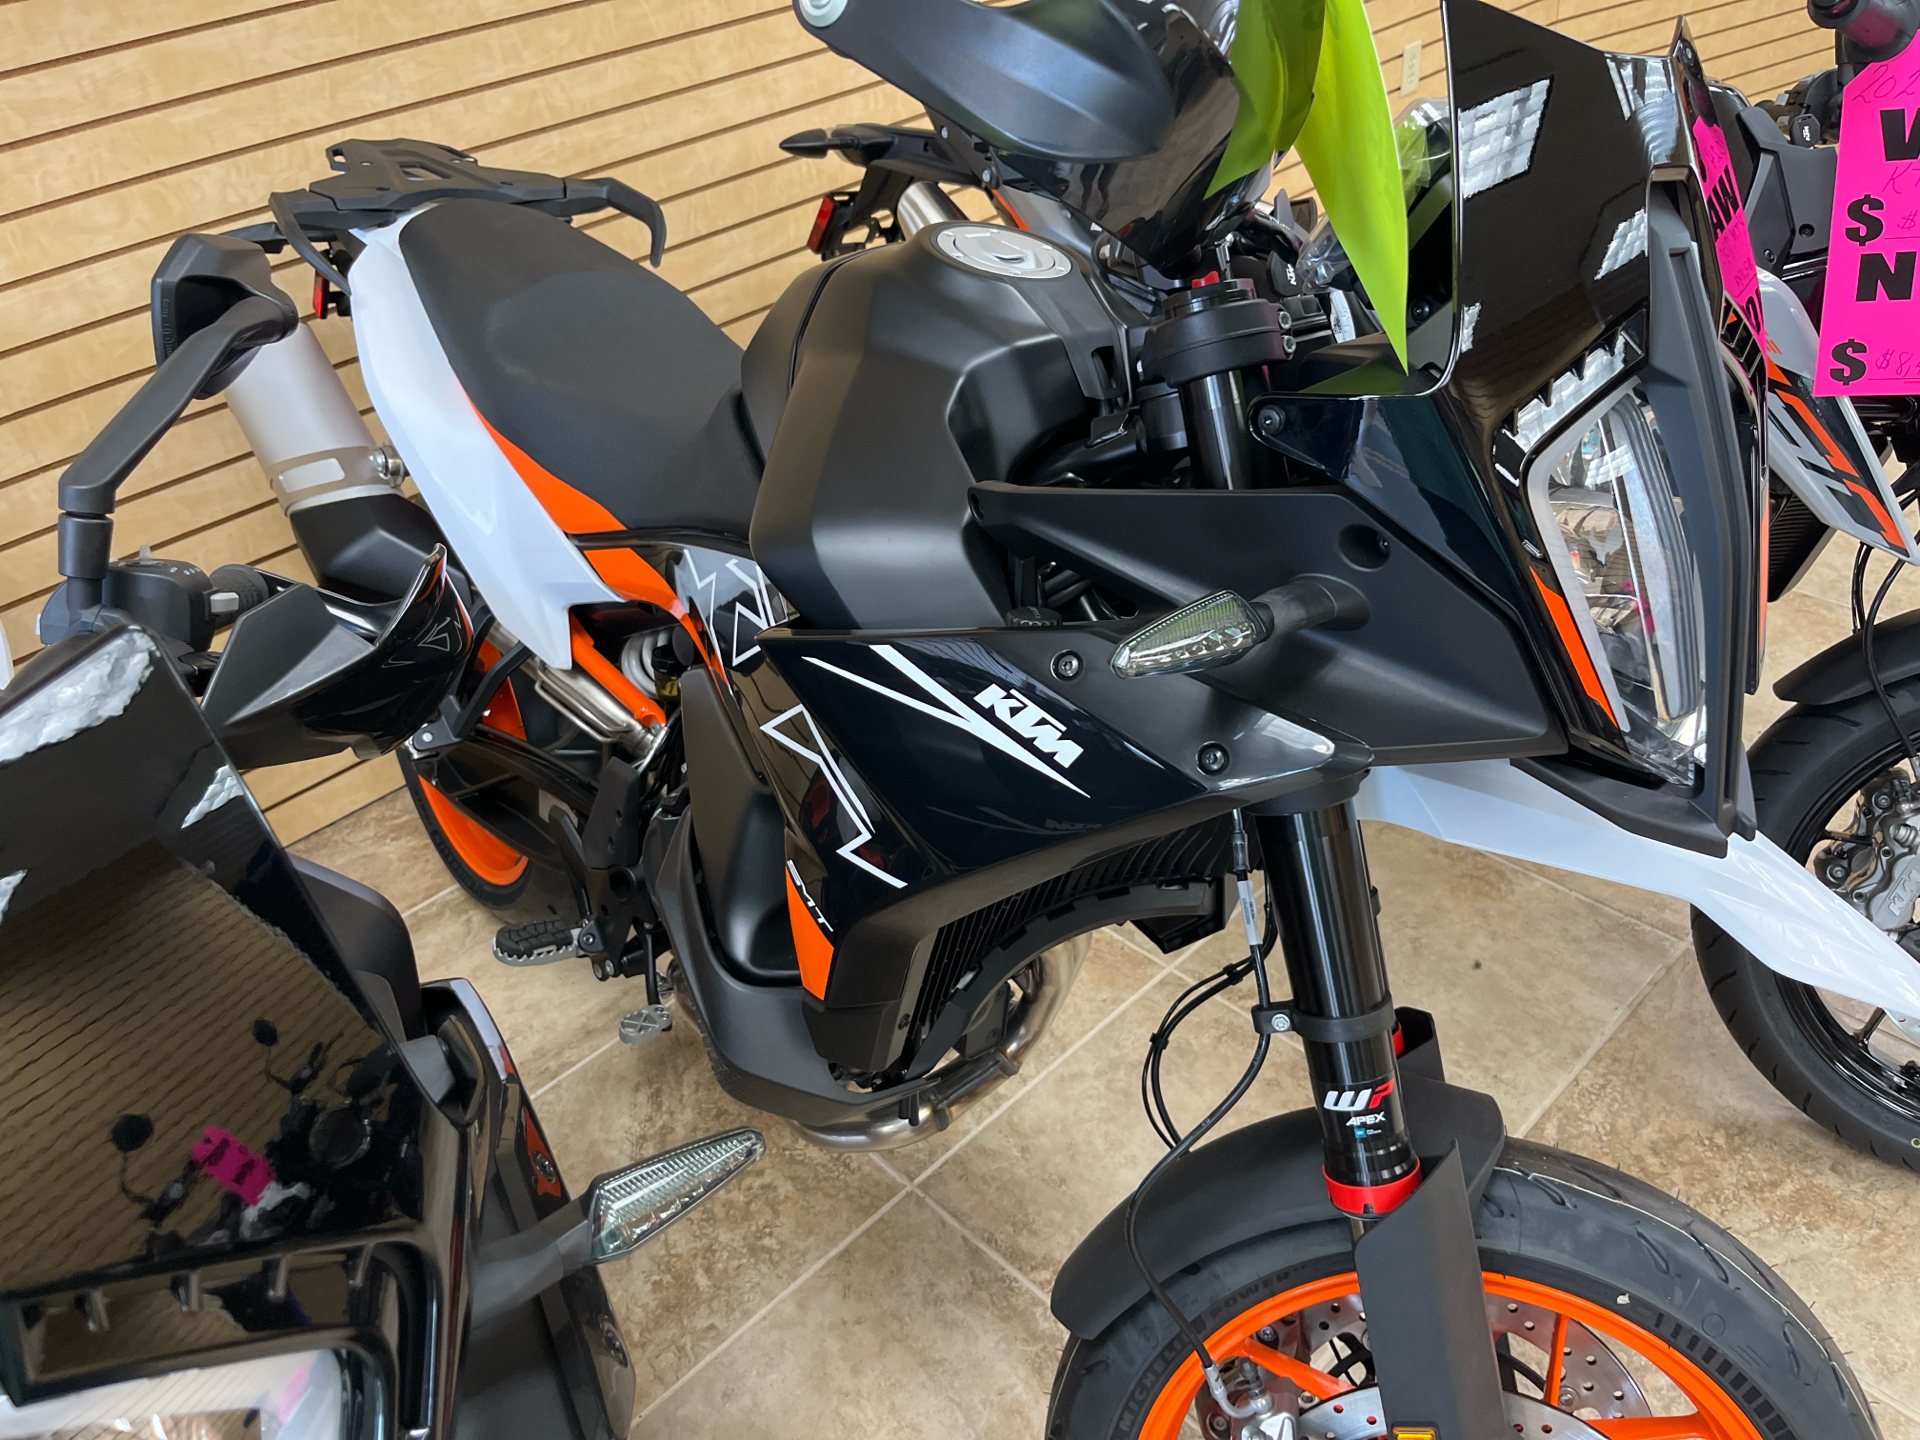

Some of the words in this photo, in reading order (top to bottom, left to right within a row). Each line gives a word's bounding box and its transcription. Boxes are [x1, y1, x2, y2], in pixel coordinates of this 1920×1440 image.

[973, 683, 1084, 769] KTM
[786, 859, 834, 932] SMT
[1323, 1078, 1395, 1111] WP
[1345, 1111, 1386, 1126] APEX
[1118, 1331, 1196, 1432] MICHELI
[1210, 1271, 1290, 1318] POWER
